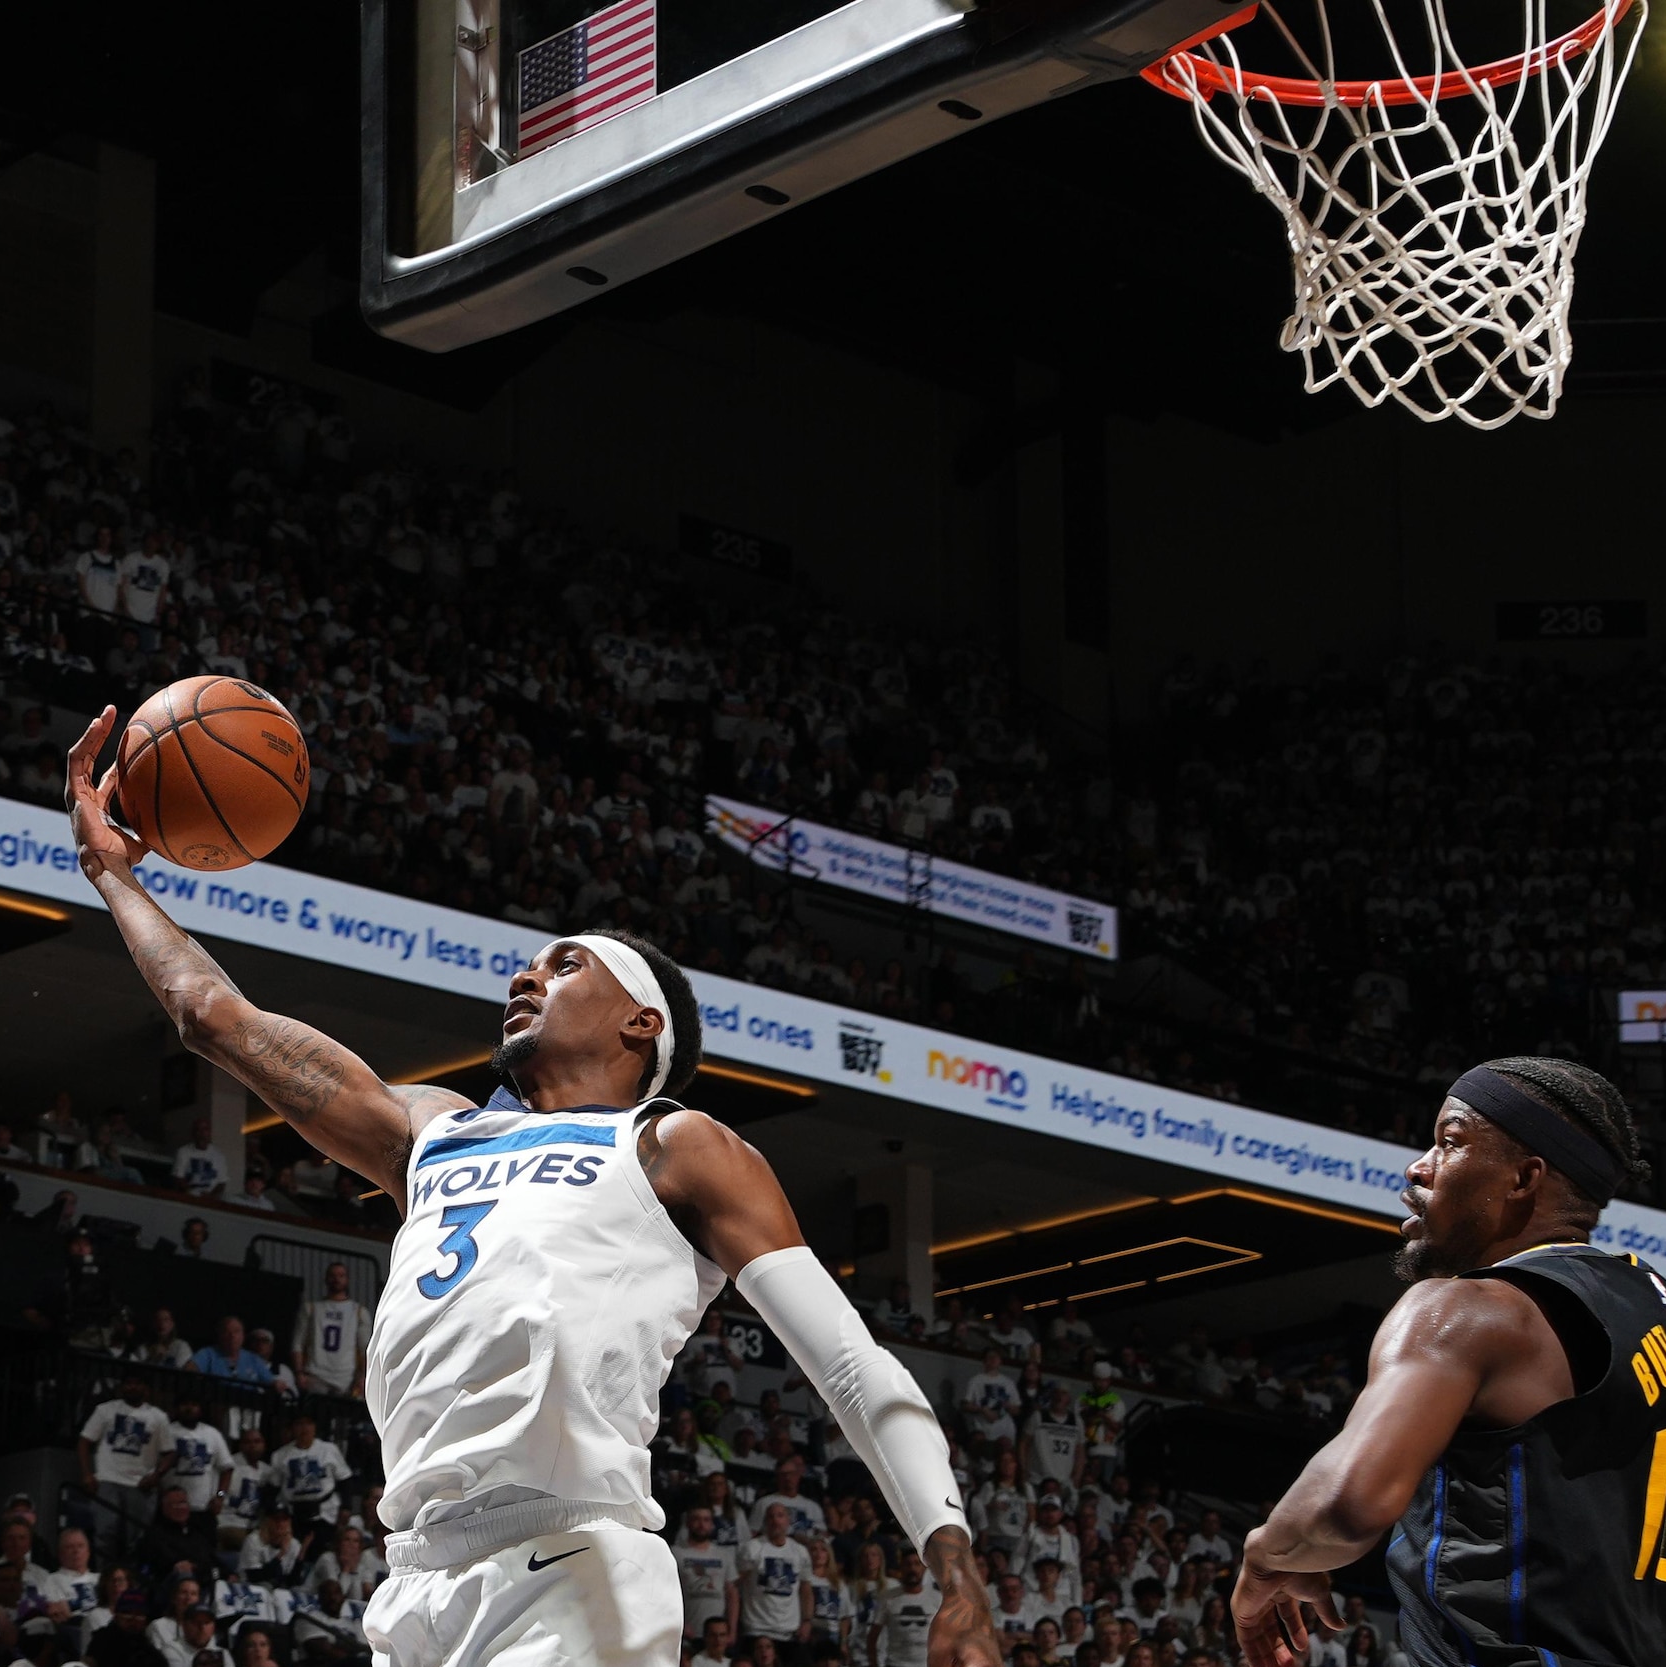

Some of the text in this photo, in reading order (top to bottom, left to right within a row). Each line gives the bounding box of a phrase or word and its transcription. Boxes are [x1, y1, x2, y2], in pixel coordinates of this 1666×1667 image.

[1538, 605, 1605, 636] 236
[133, 865, 199, 903] now
[207, 881, 290, 926] more
[298, 899, 322, 932] &
[329, 910, 418, 962] worry
[426, 927, 484, 973] less
[747, 1016, 815, 1051] ones
[838, 1030, 885, 1056] BEST
[842, 1050, 881, 1078] BUY
[927, 1050, 1028, 1100] nomo
[1050, 1081, 1147, 1138] Helping
[1153, 1107, 1228, 1157] family
[1233, 1132, 1356, 1182] caregivers
[1361, 1157, 1411, 1194] kno
[411, 1153, 605, 1214] WOLVES
[416, 1199, 500, 1301] 3
[728, 1325, 765, 1360] 33
